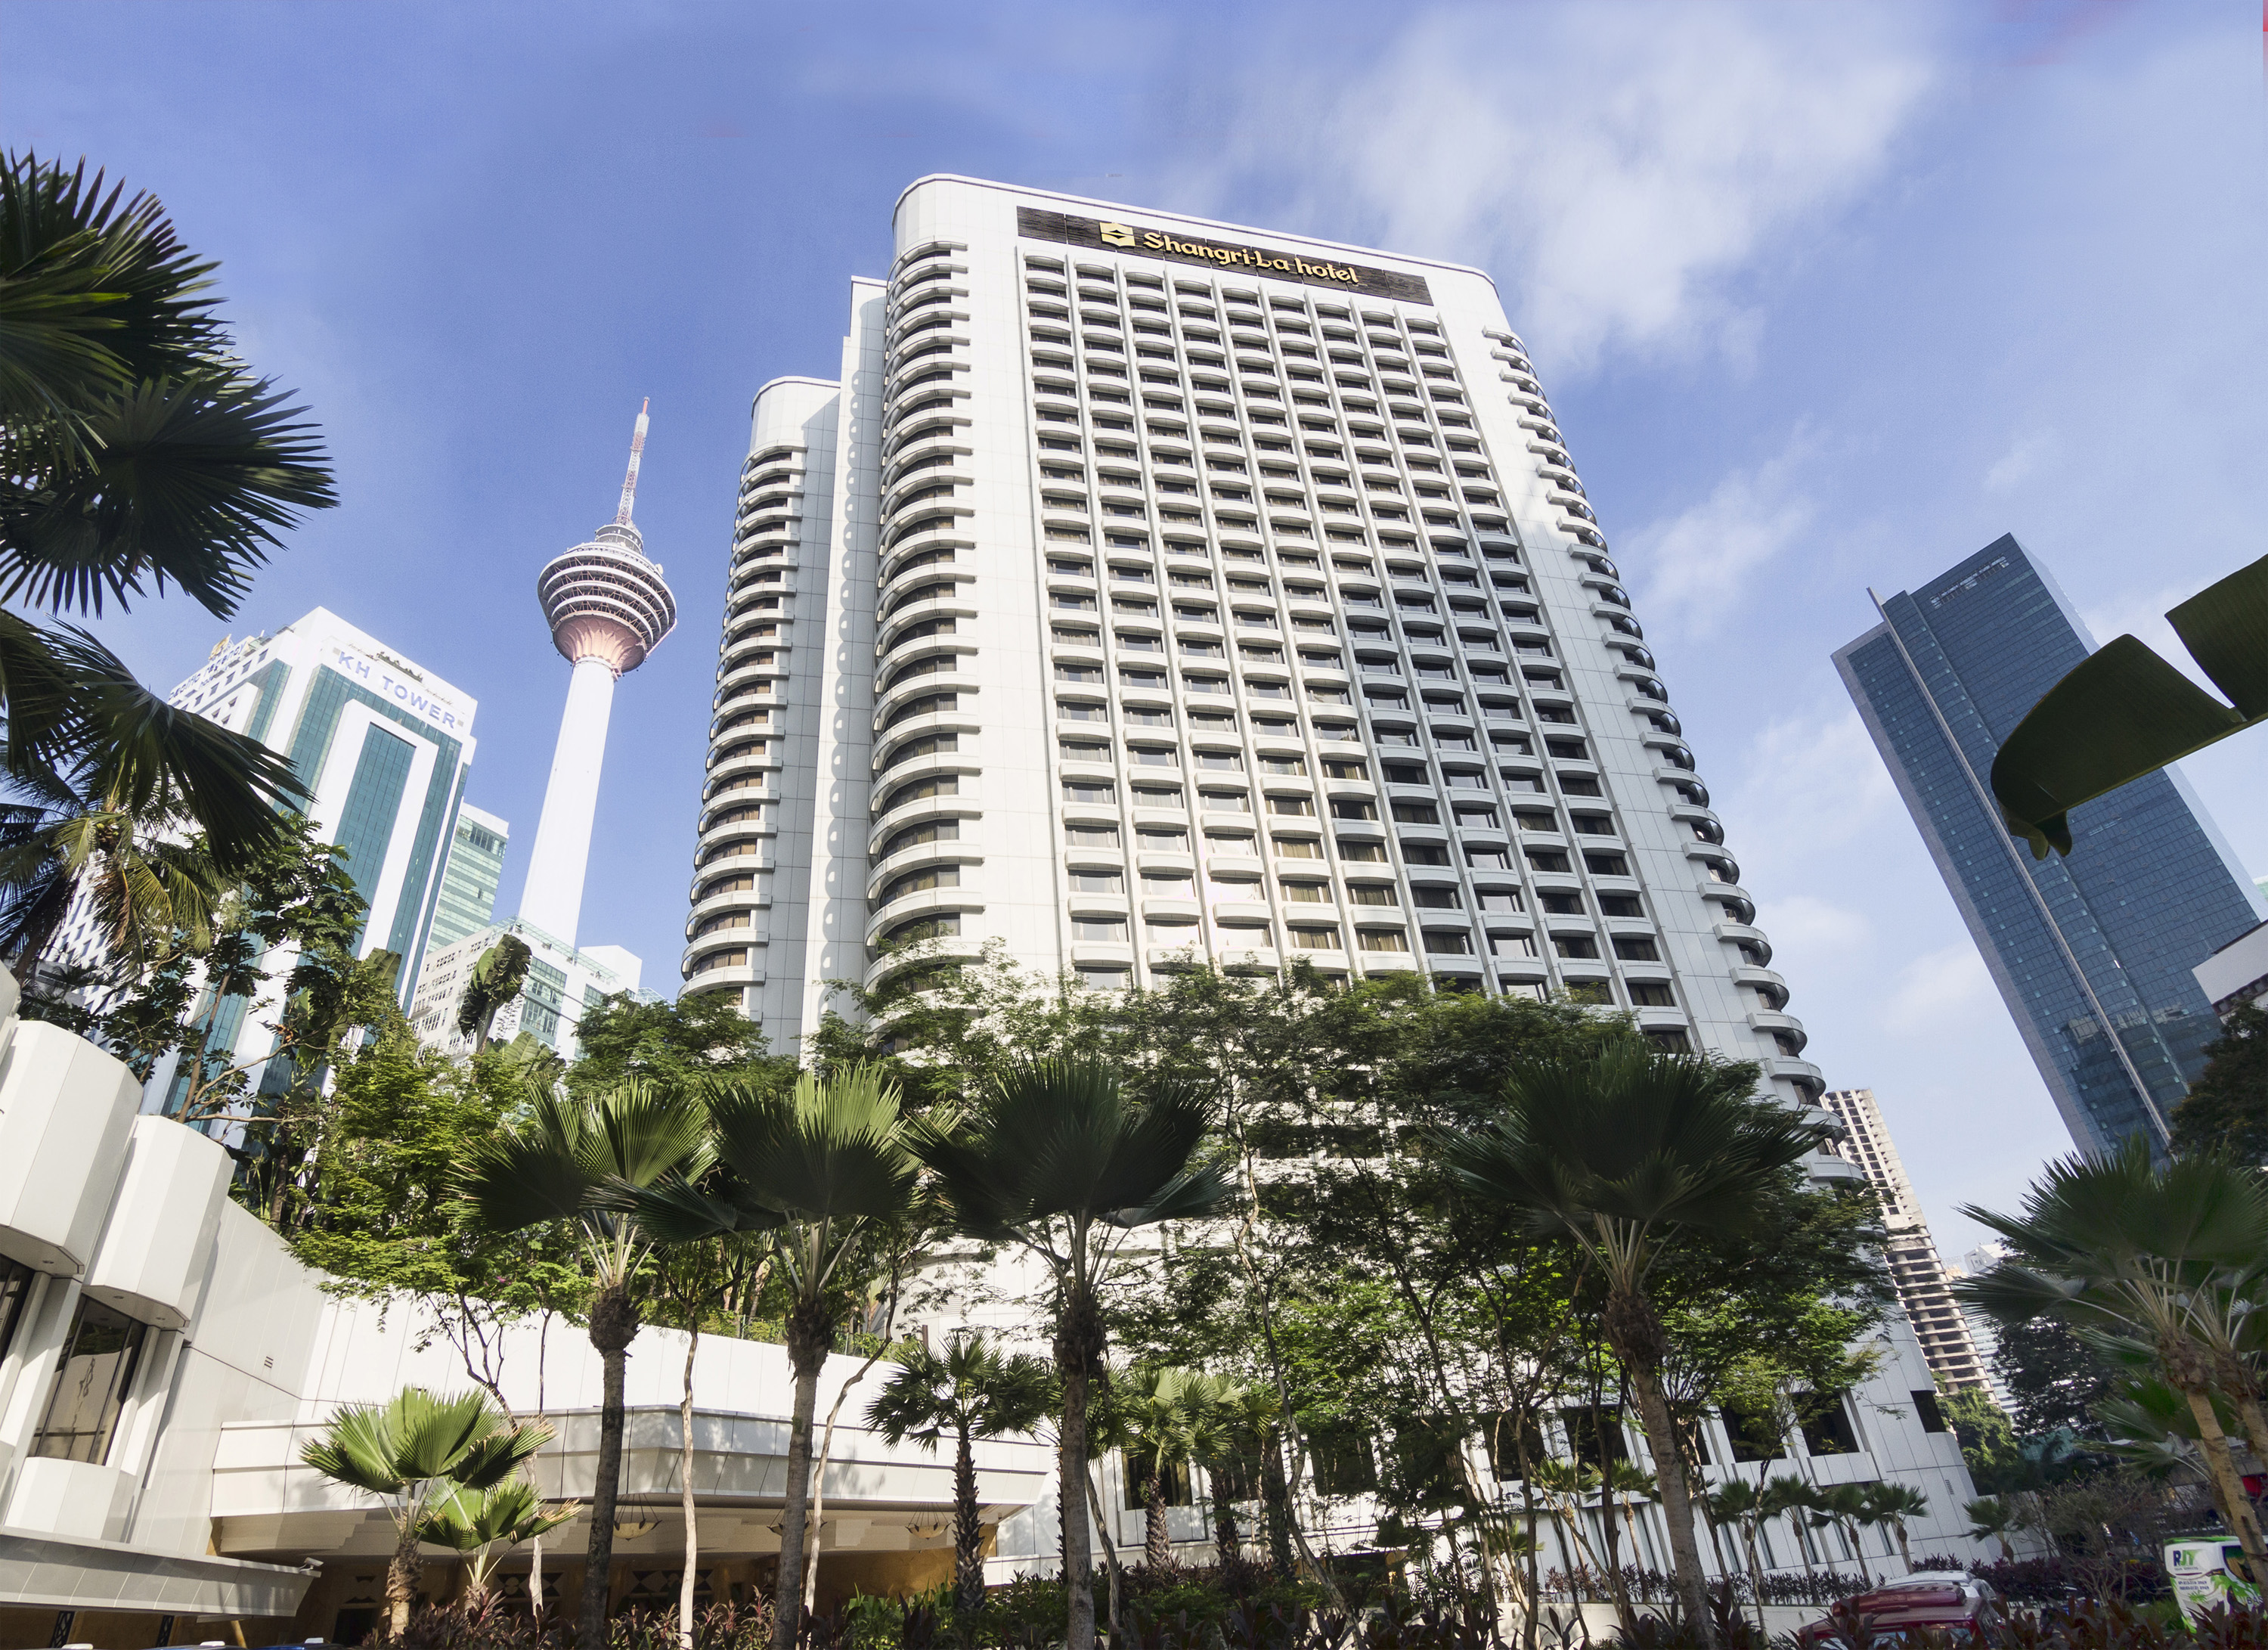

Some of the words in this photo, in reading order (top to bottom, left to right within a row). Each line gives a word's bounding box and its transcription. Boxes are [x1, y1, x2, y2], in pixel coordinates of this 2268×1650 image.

[1143, 231, 1290, 271] Shangri-La
[1294, 256, 1359, 284] hotel
[338, 651, 370, 679] KH
[382, 675, 456, 729] TOWER
